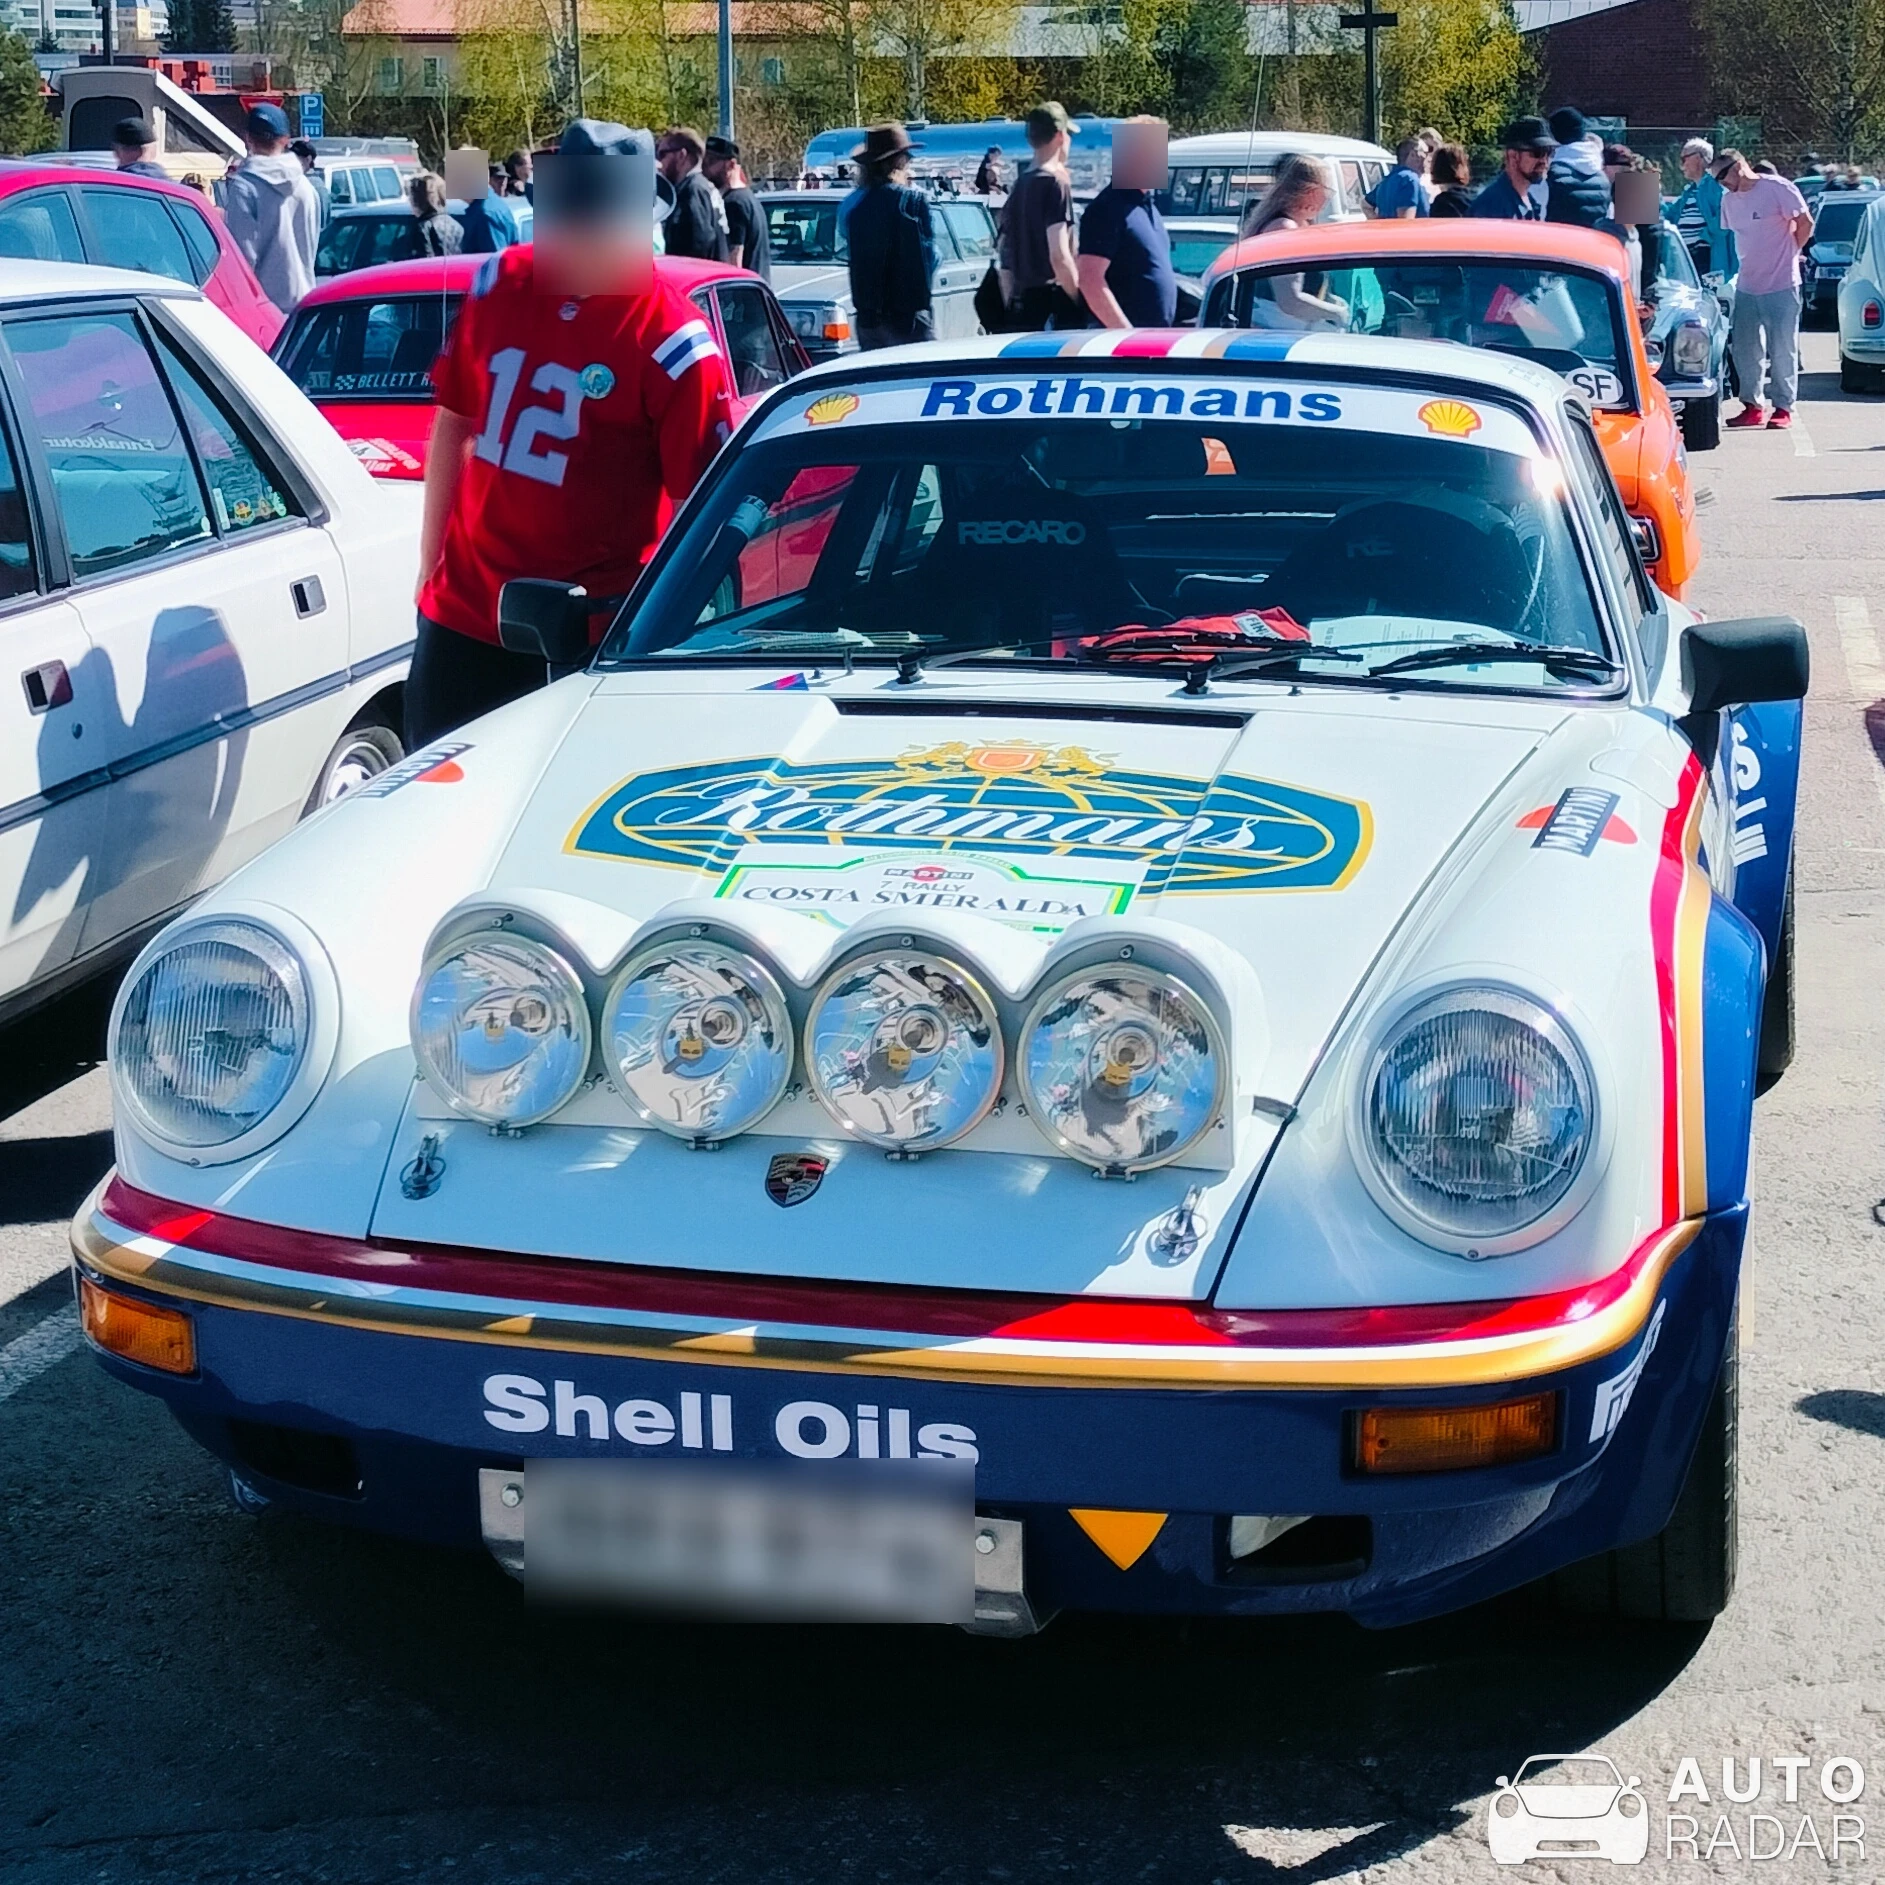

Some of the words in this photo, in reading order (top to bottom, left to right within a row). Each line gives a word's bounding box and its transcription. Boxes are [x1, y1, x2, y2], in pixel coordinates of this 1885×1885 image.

[304, 96, 319, 115] P
[357, 372, 416, 388] BELLETT
[1572, 373, 1611, 400] SF
[920, 378, 1342, 421] Rothmans
[475, 346, 584, 487] 12
[957, 520, 1086, 545] RECARO
[655, 777, 1284, 856] Rothmans
[1540, 787, 1612, 853] MARTINI
[880, 881, 889, 890] 7
[902, 882, 966, 893] RALLY
[890, 868, 970, 880] MARTINI
[743, 887, 859, 903] COSTA
[870, 890, 1087, 917] SMERALDA
[483, 1374, 734, 1452] Shell
[775, 1401, 979, 1465] Oils
